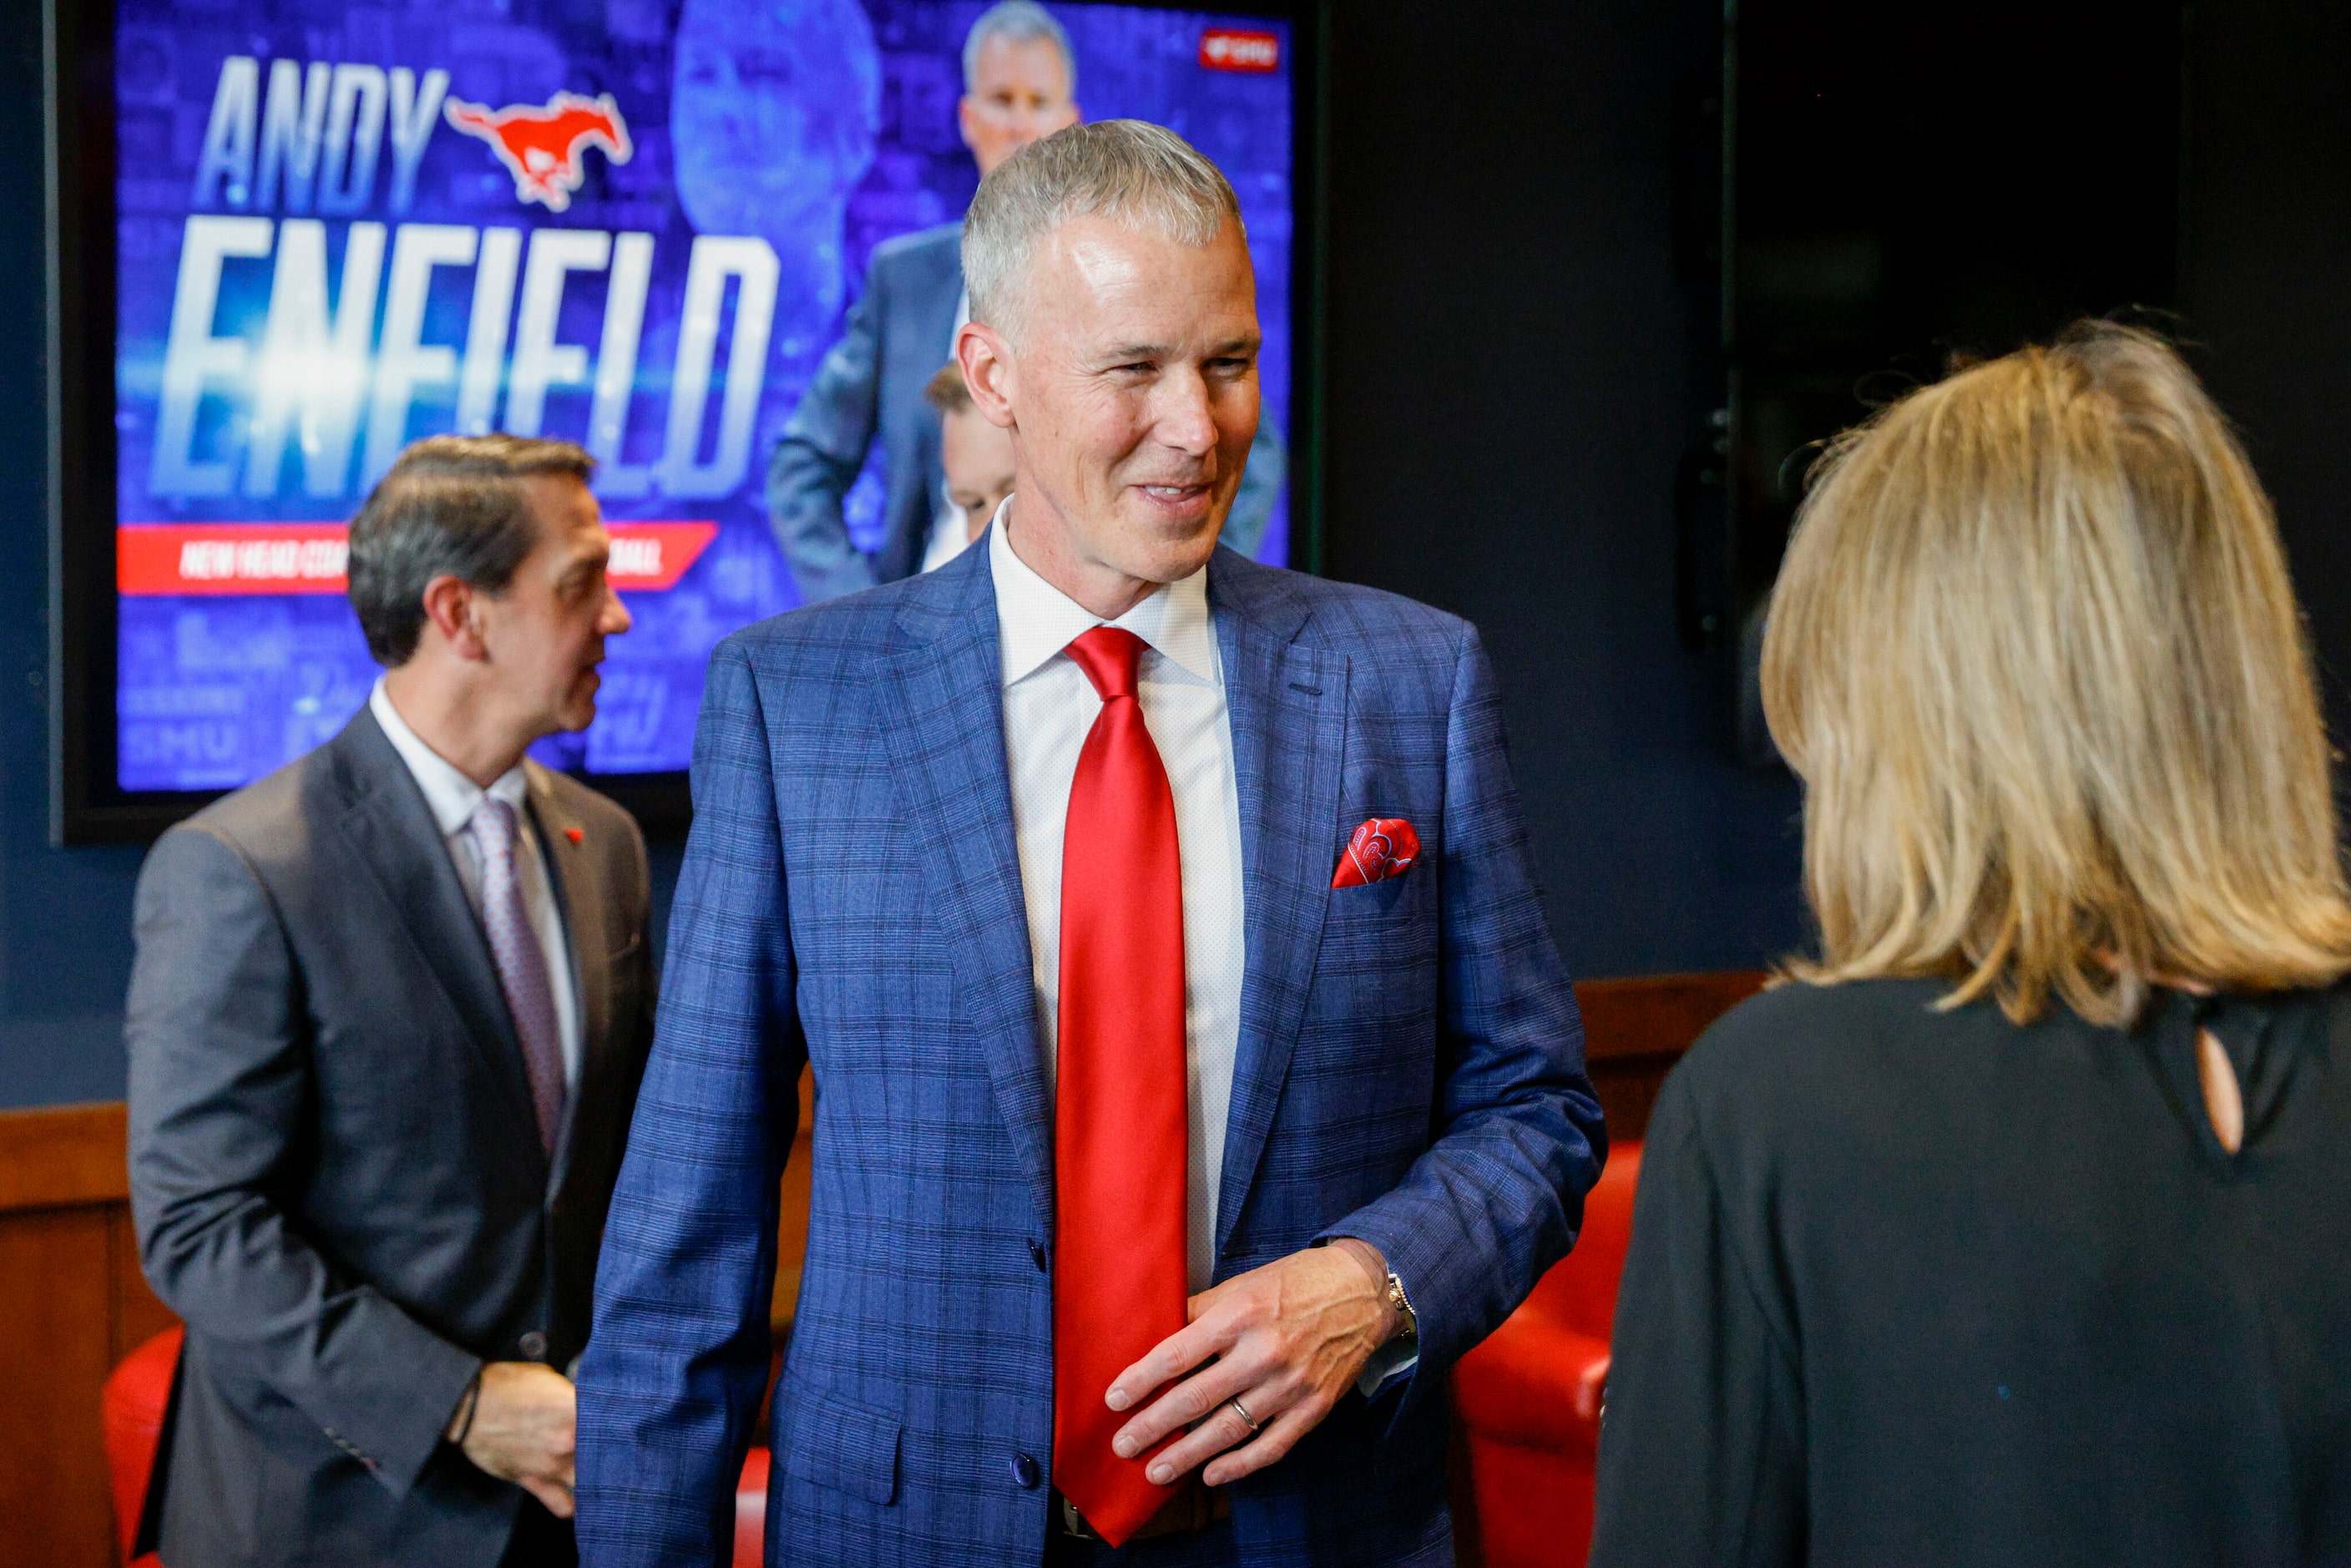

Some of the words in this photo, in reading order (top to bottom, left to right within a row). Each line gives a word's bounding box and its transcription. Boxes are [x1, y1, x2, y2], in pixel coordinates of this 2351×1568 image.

[191, 55, 452, 215] ANDY
[149, 215, 782, 498] ENFIELD
[179, 539, 235, 579] NEW
[235, 539, 301, 579] HEAD
